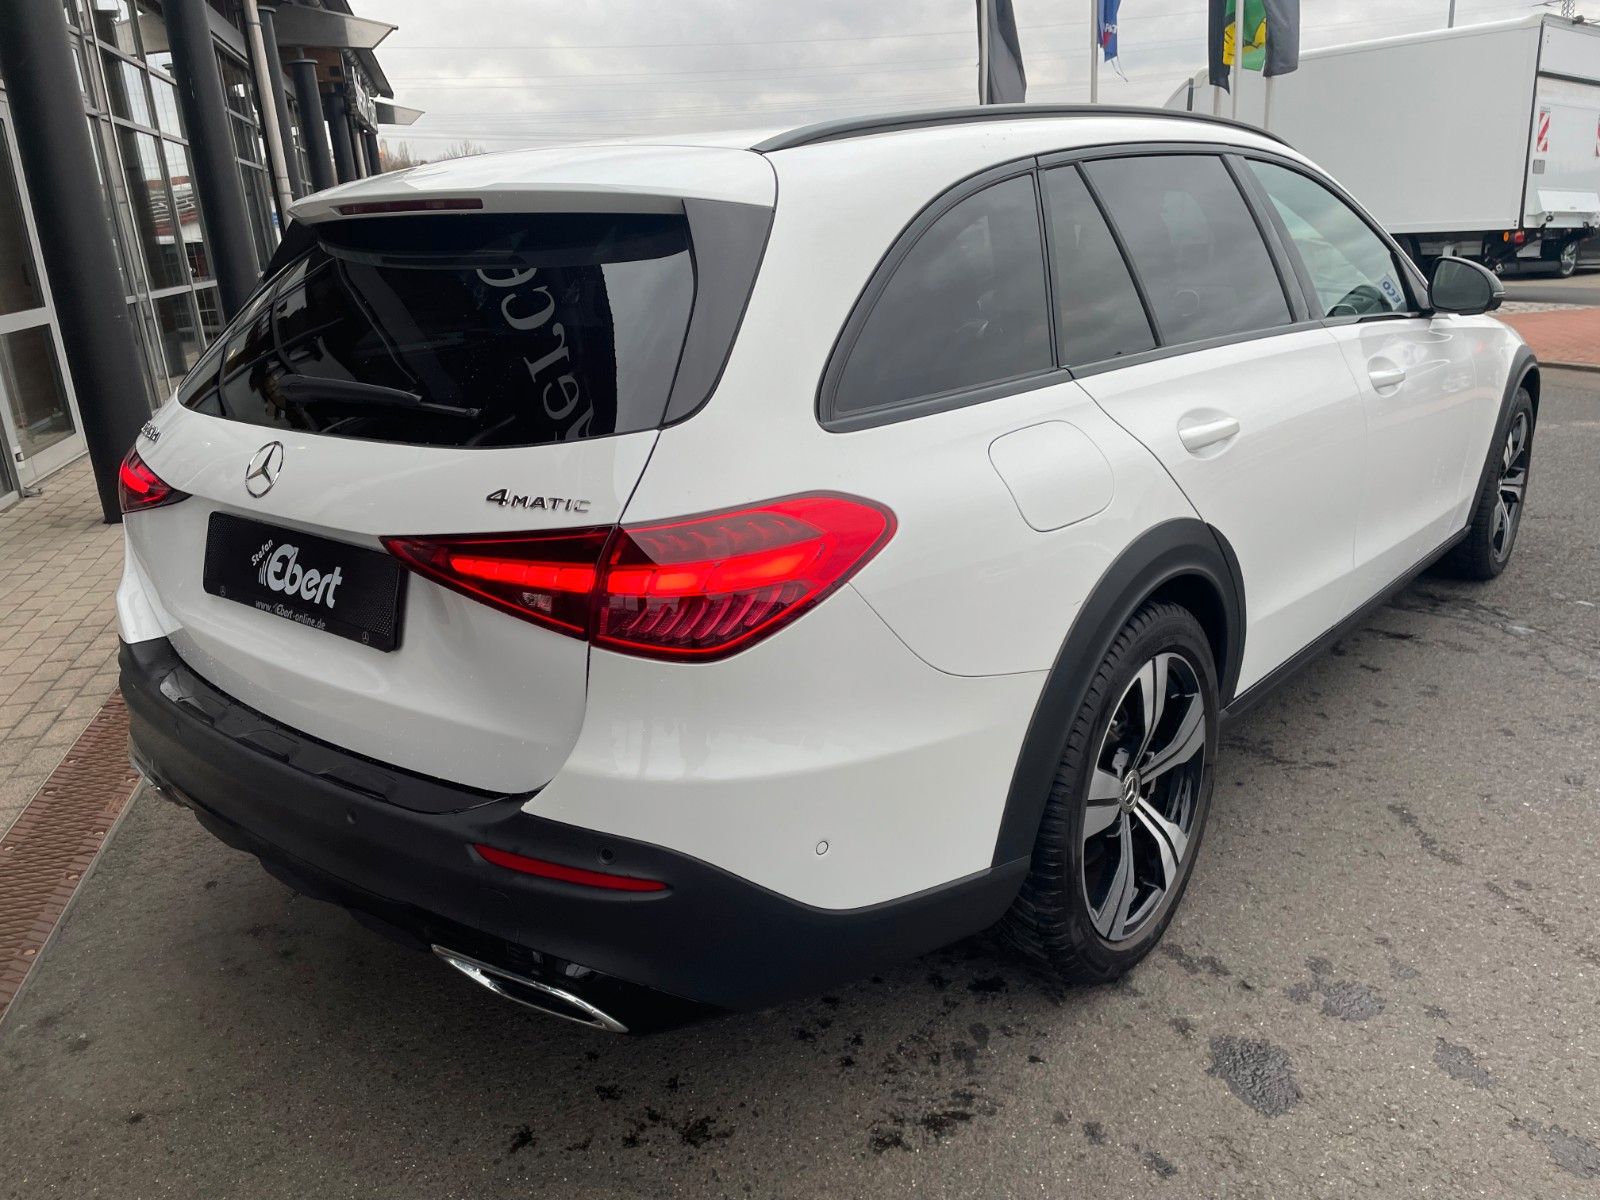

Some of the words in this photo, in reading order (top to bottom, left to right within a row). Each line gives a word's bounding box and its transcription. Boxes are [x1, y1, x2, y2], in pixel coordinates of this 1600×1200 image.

[1382, 280, 1402, 304] ECO
[486, 488, 591, 513] 4MATIC
[251, 539, 274, 567] Stefan
[267, 543, 343, 609] Ebert
